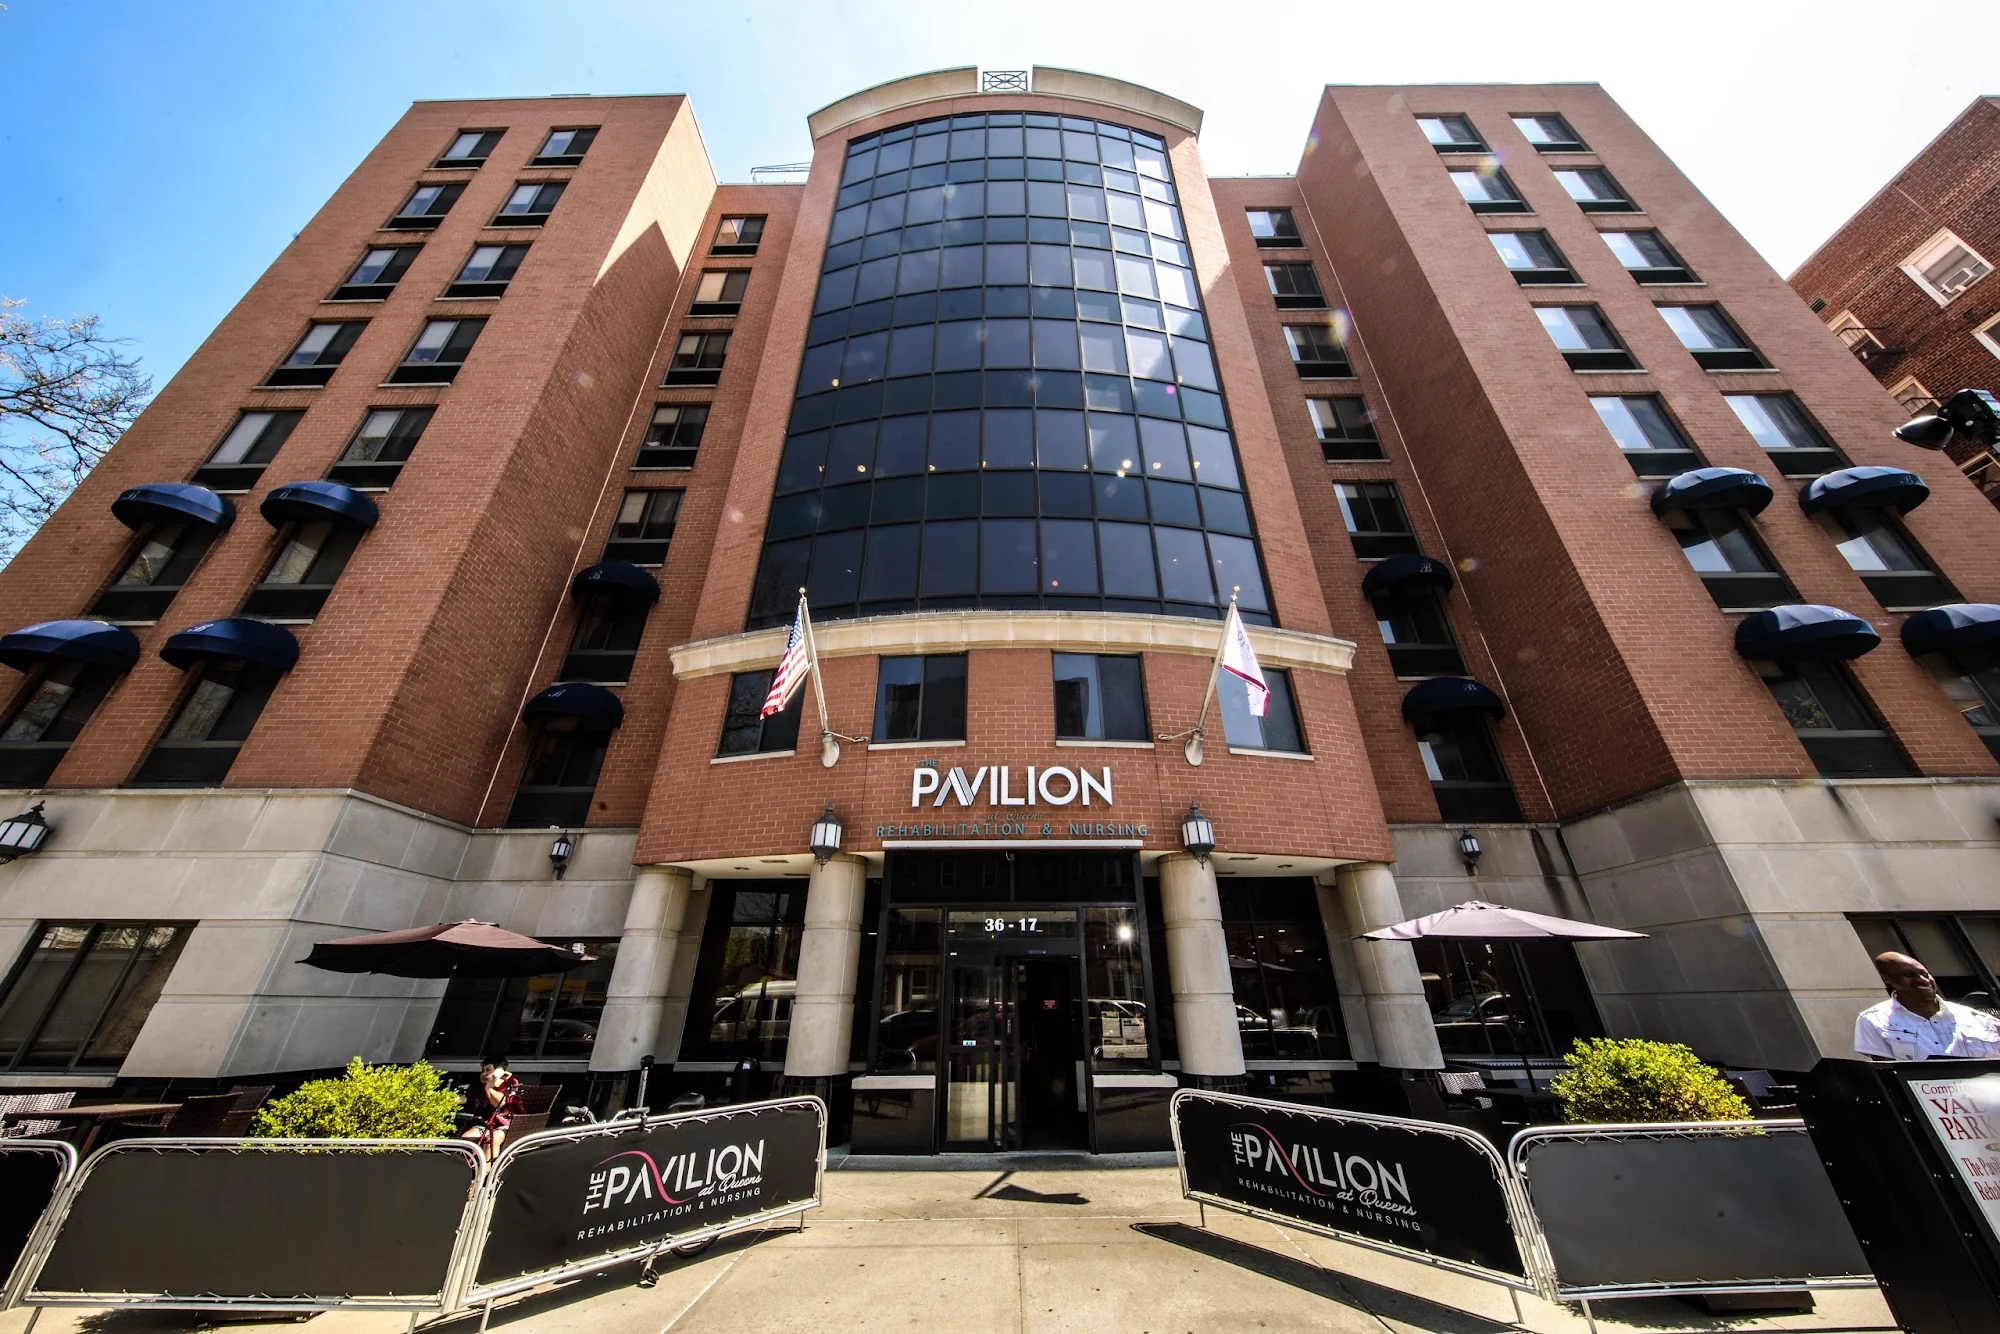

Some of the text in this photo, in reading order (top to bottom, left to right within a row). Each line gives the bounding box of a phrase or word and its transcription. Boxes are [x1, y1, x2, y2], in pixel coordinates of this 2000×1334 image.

[911, 766, 1113, 808] PAVILION
[876, 822, 1148, 838] REHABILITATION & NURSING
[987, 807, 1043, 822] at Queens
[1230, 1131, 1246, 1165] THE
[1960, 1157, 1984, 1176] The
[603, 1139, 764, 1209] PAVILION
[698, 1172, 762, 1197] at Queens
[1243, 1133, 1411, 1204] PAVILION
[583, 1170, 607, 1215] THE
[1238, 1177, 1421, 1231] REHABILITATION & NURSING
[1336, 1189, 1417, 1216] at Queens
[577, 1187, 760, 1240] REHABILITATION & NURSING
